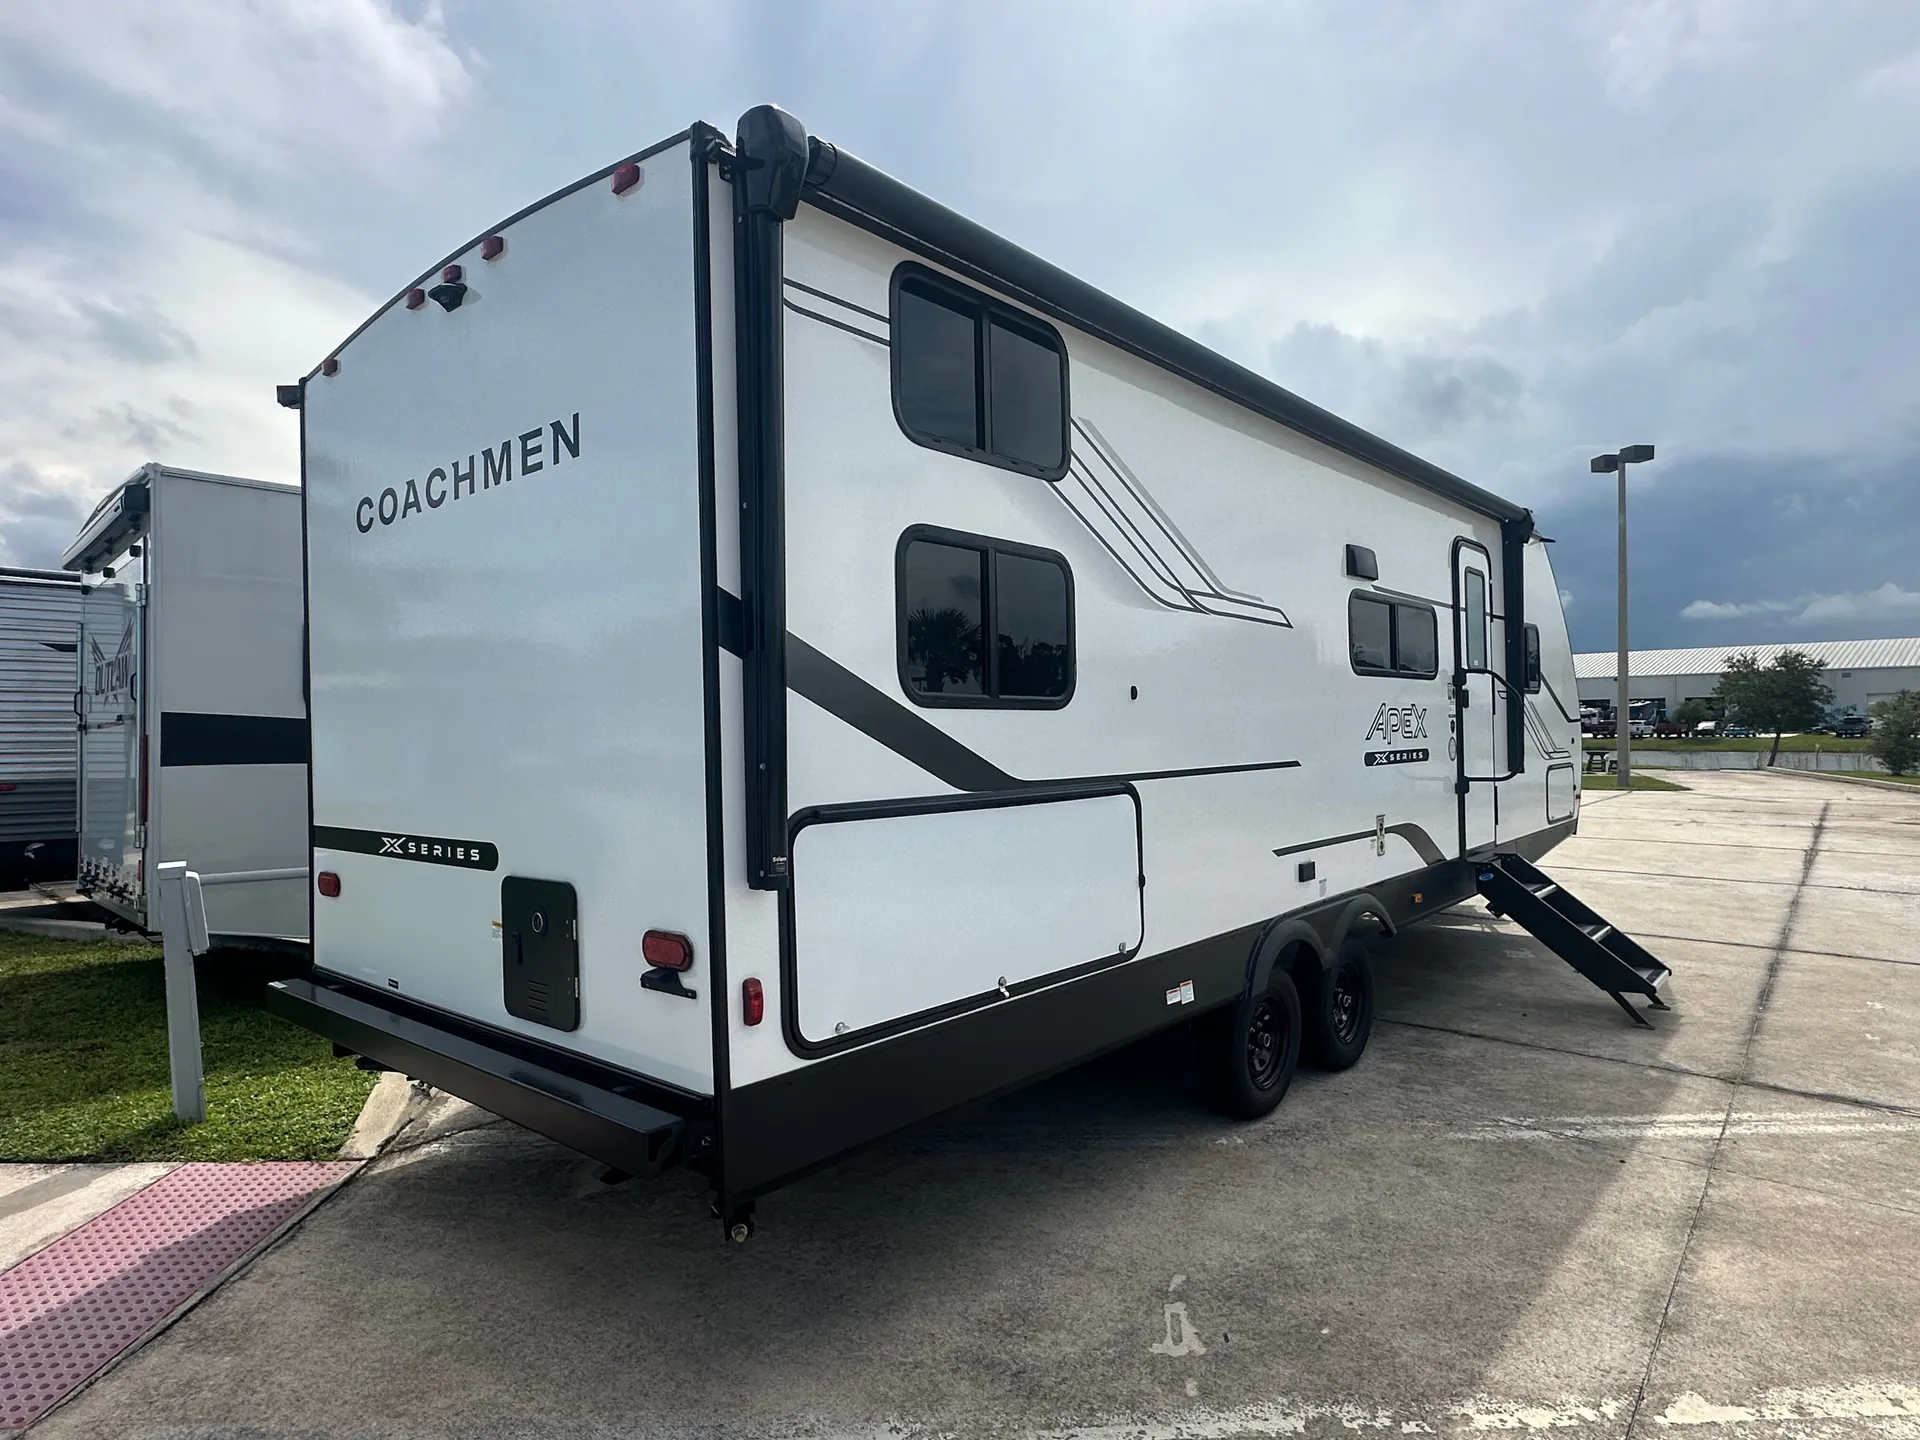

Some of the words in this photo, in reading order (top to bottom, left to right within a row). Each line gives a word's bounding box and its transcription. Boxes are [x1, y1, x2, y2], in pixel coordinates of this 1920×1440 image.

[356, 412, 580, 533] COACHMEN
[95, 653, 133, 695] OUTLAW
[1373, 752, 1389, 766] X
[1389, 752, 1423, 761] SERIES
[379, 837, 406, 854] X
[408, 842, 480, 861] SERIES
